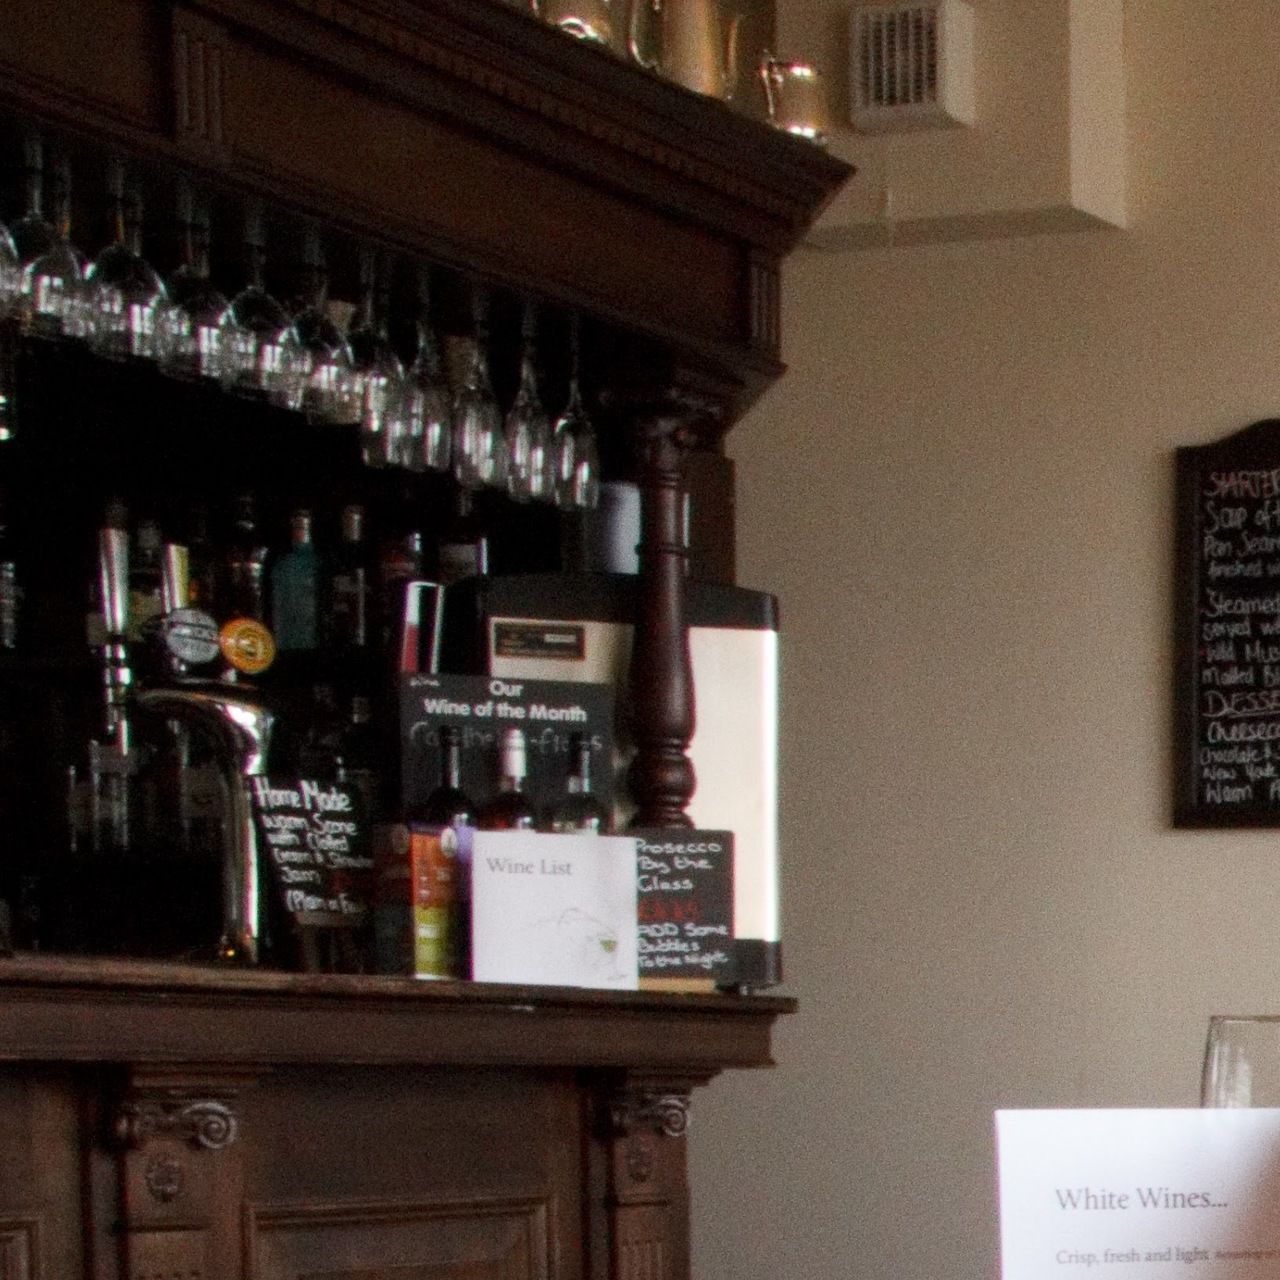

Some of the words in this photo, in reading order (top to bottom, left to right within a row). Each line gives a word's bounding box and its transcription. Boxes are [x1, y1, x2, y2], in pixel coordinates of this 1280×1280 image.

[489, 680, 524, 698] Our
[423, 698, 470, 716] Wine
[473, 701, 494, 718] of
[495, 702, 526, 720] the
[528, 704, 588, 723] Month
[253, 776, 302, 808] Home
[301, 779, 354, 812] Made
[638, 839, 722, 855] Prosecco
[486, 857, 535, 874] Wine
[540, 859, 573, 876] List
[638, 875, 694, 892] Glass
[1056, 1187, 1131, 1210] White
[1104, 1247, 1141, 1263] fresh
[1145, 1246, 1173, 1262] and
